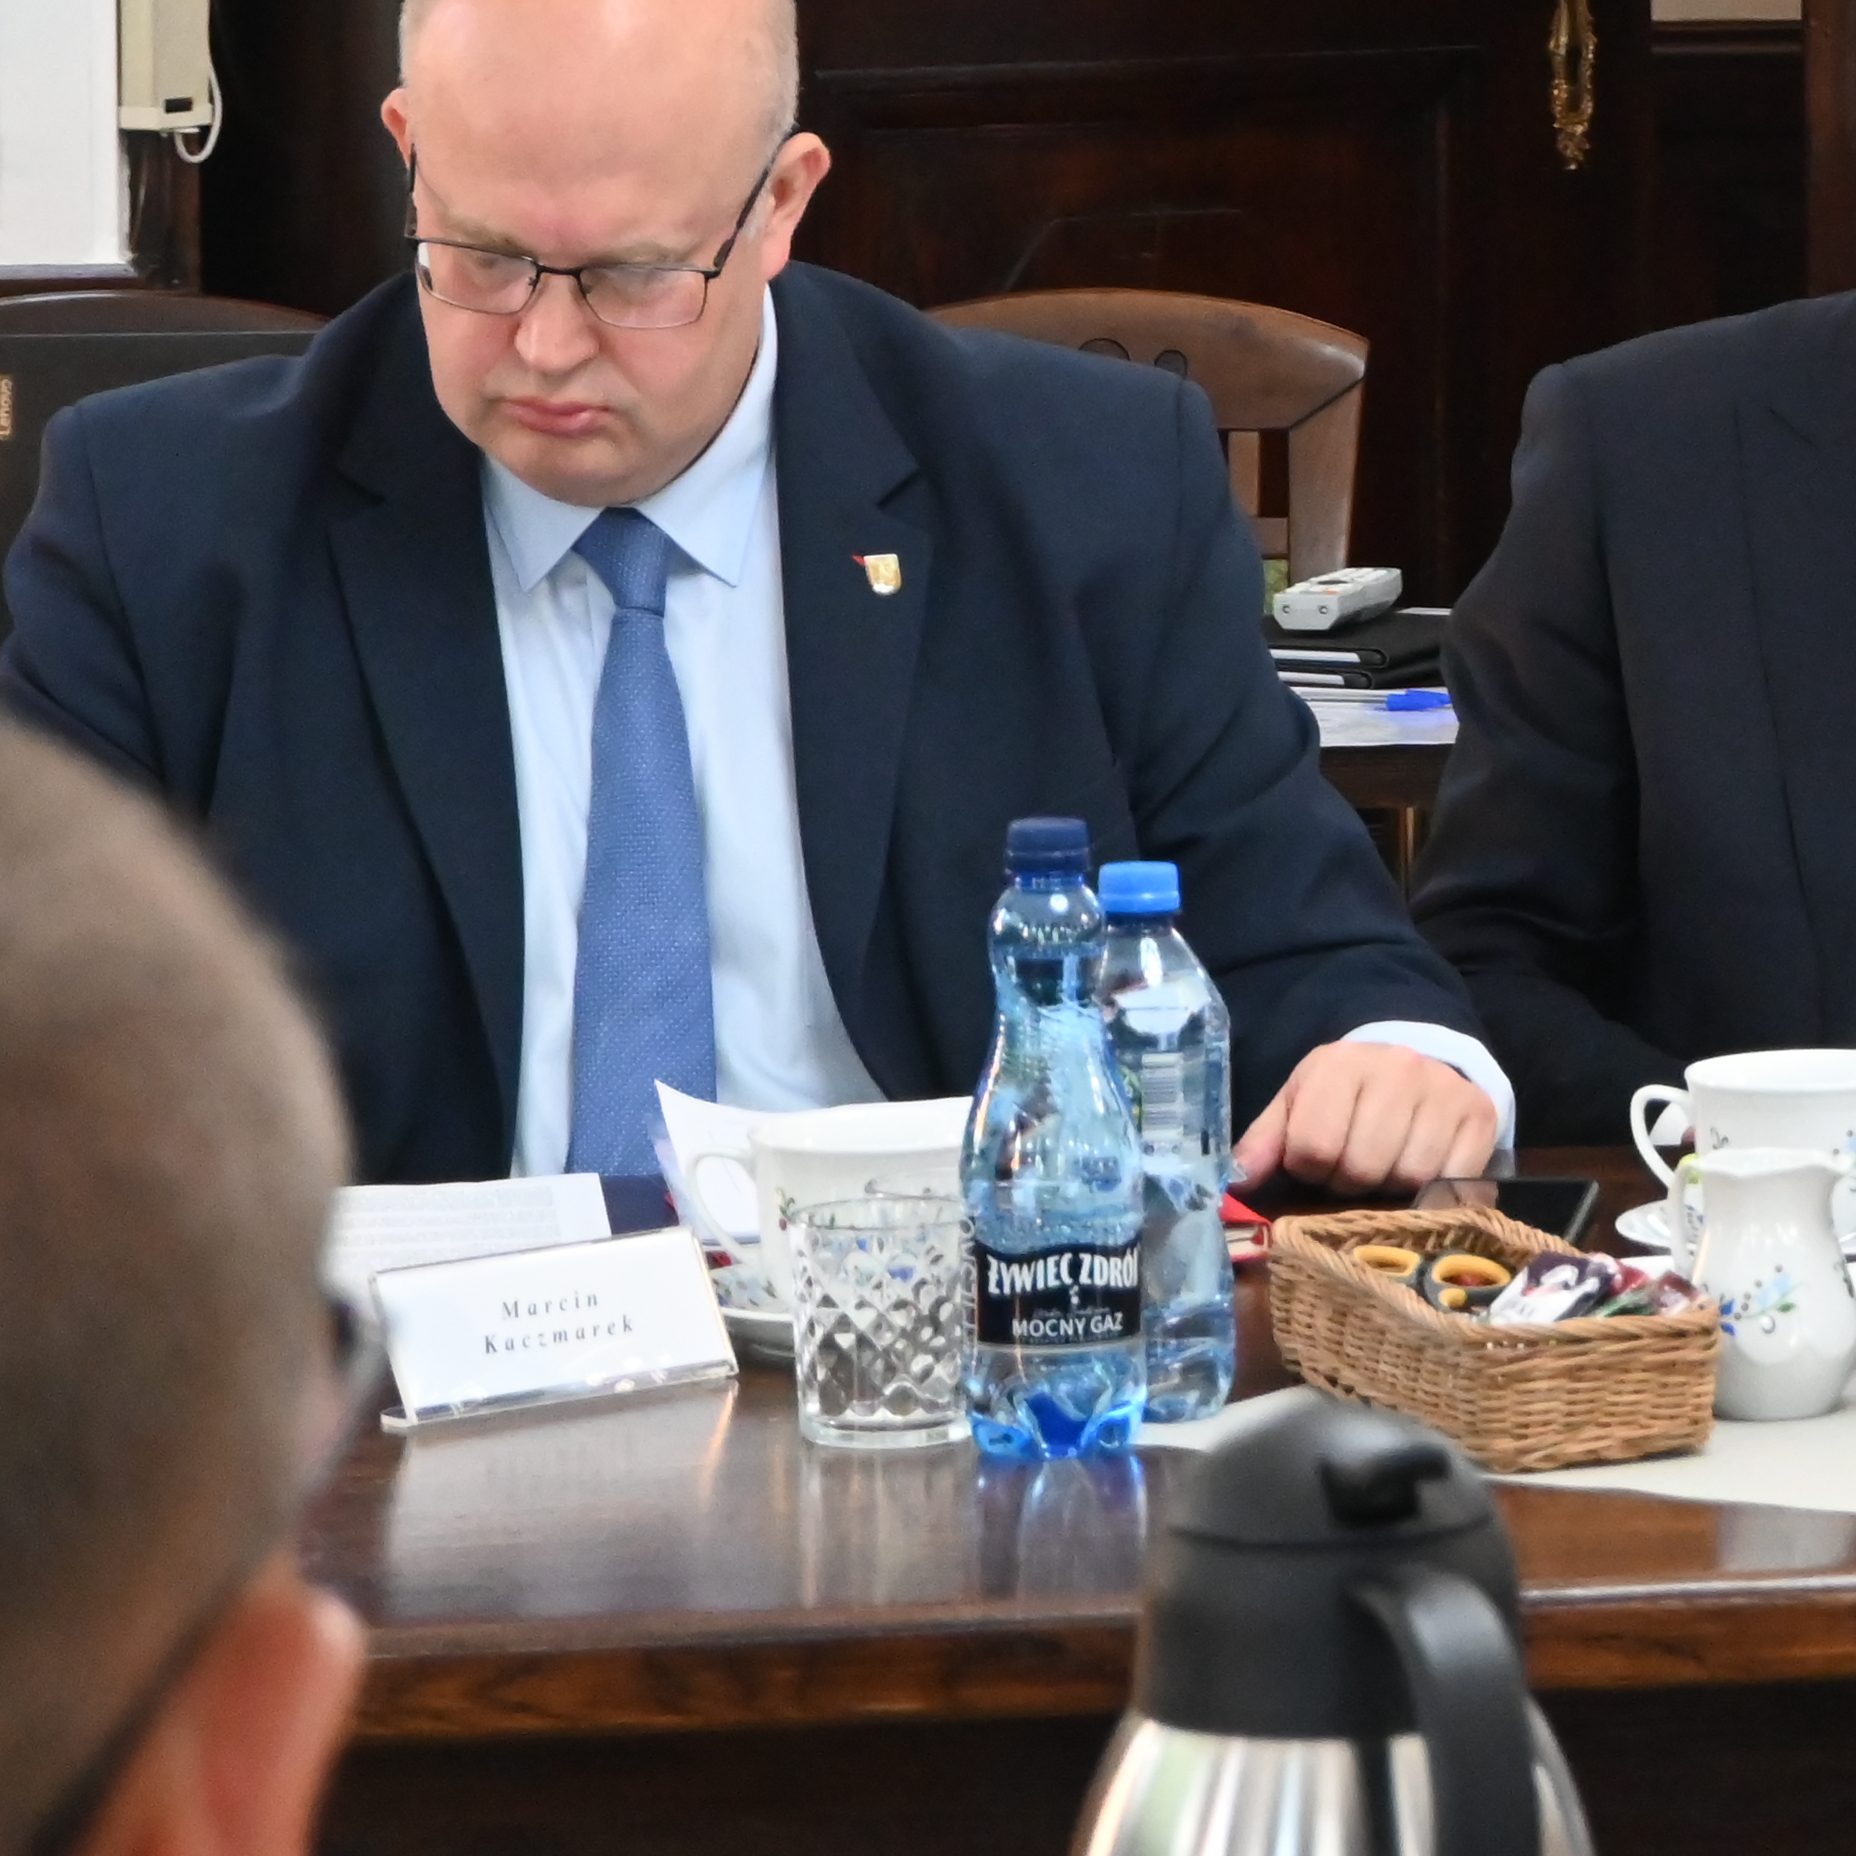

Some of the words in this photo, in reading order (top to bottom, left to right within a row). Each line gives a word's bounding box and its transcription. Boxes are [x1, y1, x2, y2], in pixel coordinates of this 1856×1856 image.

[986, 1252, 1074, 1295] ŻYWIEC
[501, 1290, 599, 1320] Marcin
[483, 1313, 634, 1355] Kaczmarek
[1012, 1317, 1087, 1338] MOCNY
[1089, 1312, 1124, 1334] GAZ
